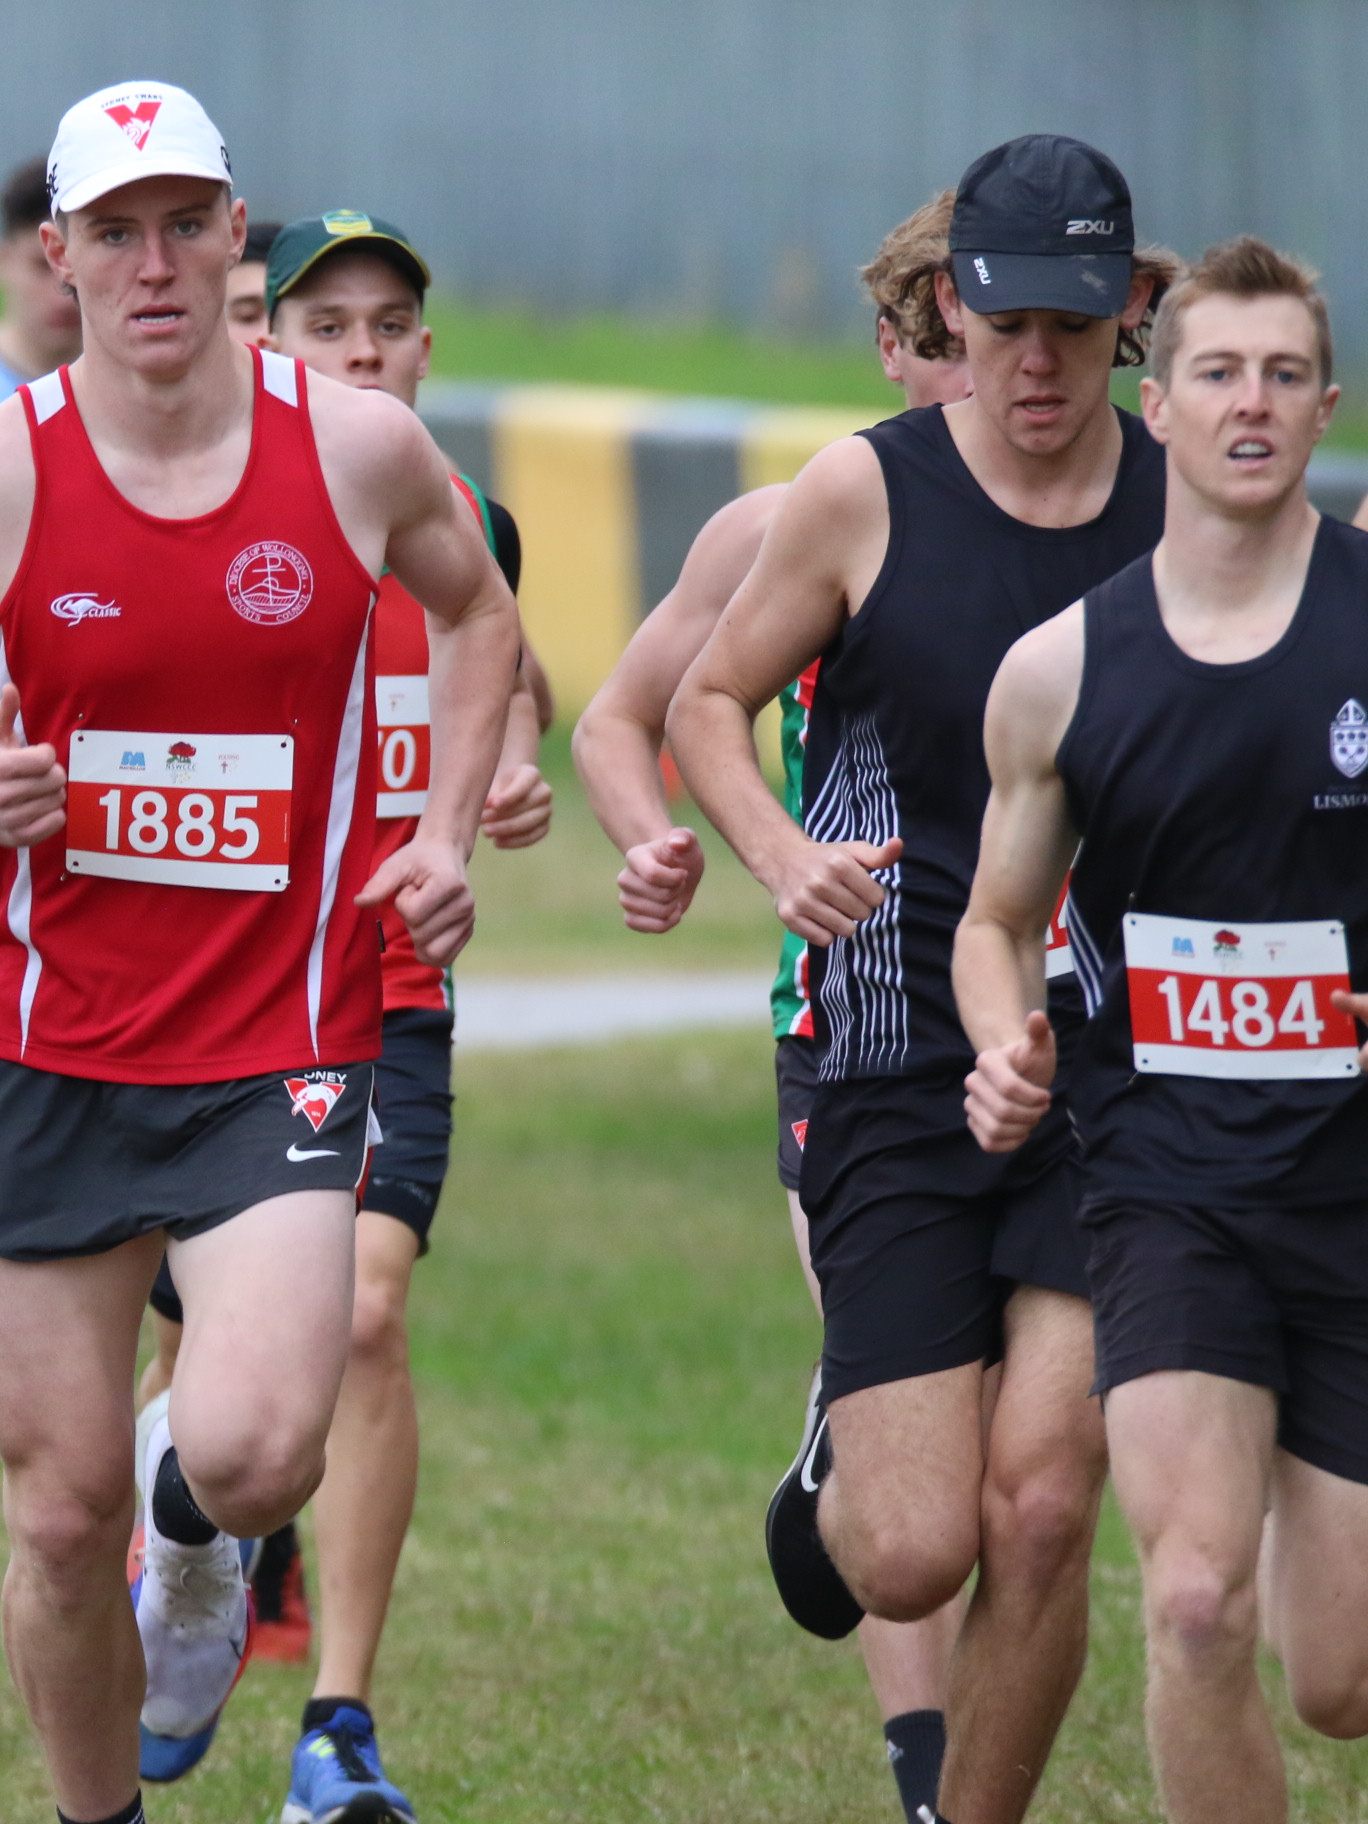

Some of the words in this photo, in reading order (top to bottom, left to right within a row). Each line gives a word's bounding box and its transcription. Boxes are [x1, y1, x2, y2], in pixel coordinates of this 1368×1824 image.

[88, 606, 122, 618] CLASSIC
[232, 594, 262, 622] SPORTS
[276, 593, 310, 622] COUNCIL
[377, 728, 417, 790] 0
[99, 788, 260, 860] 1885
[1157, 975, 1325, 1047] 1484
